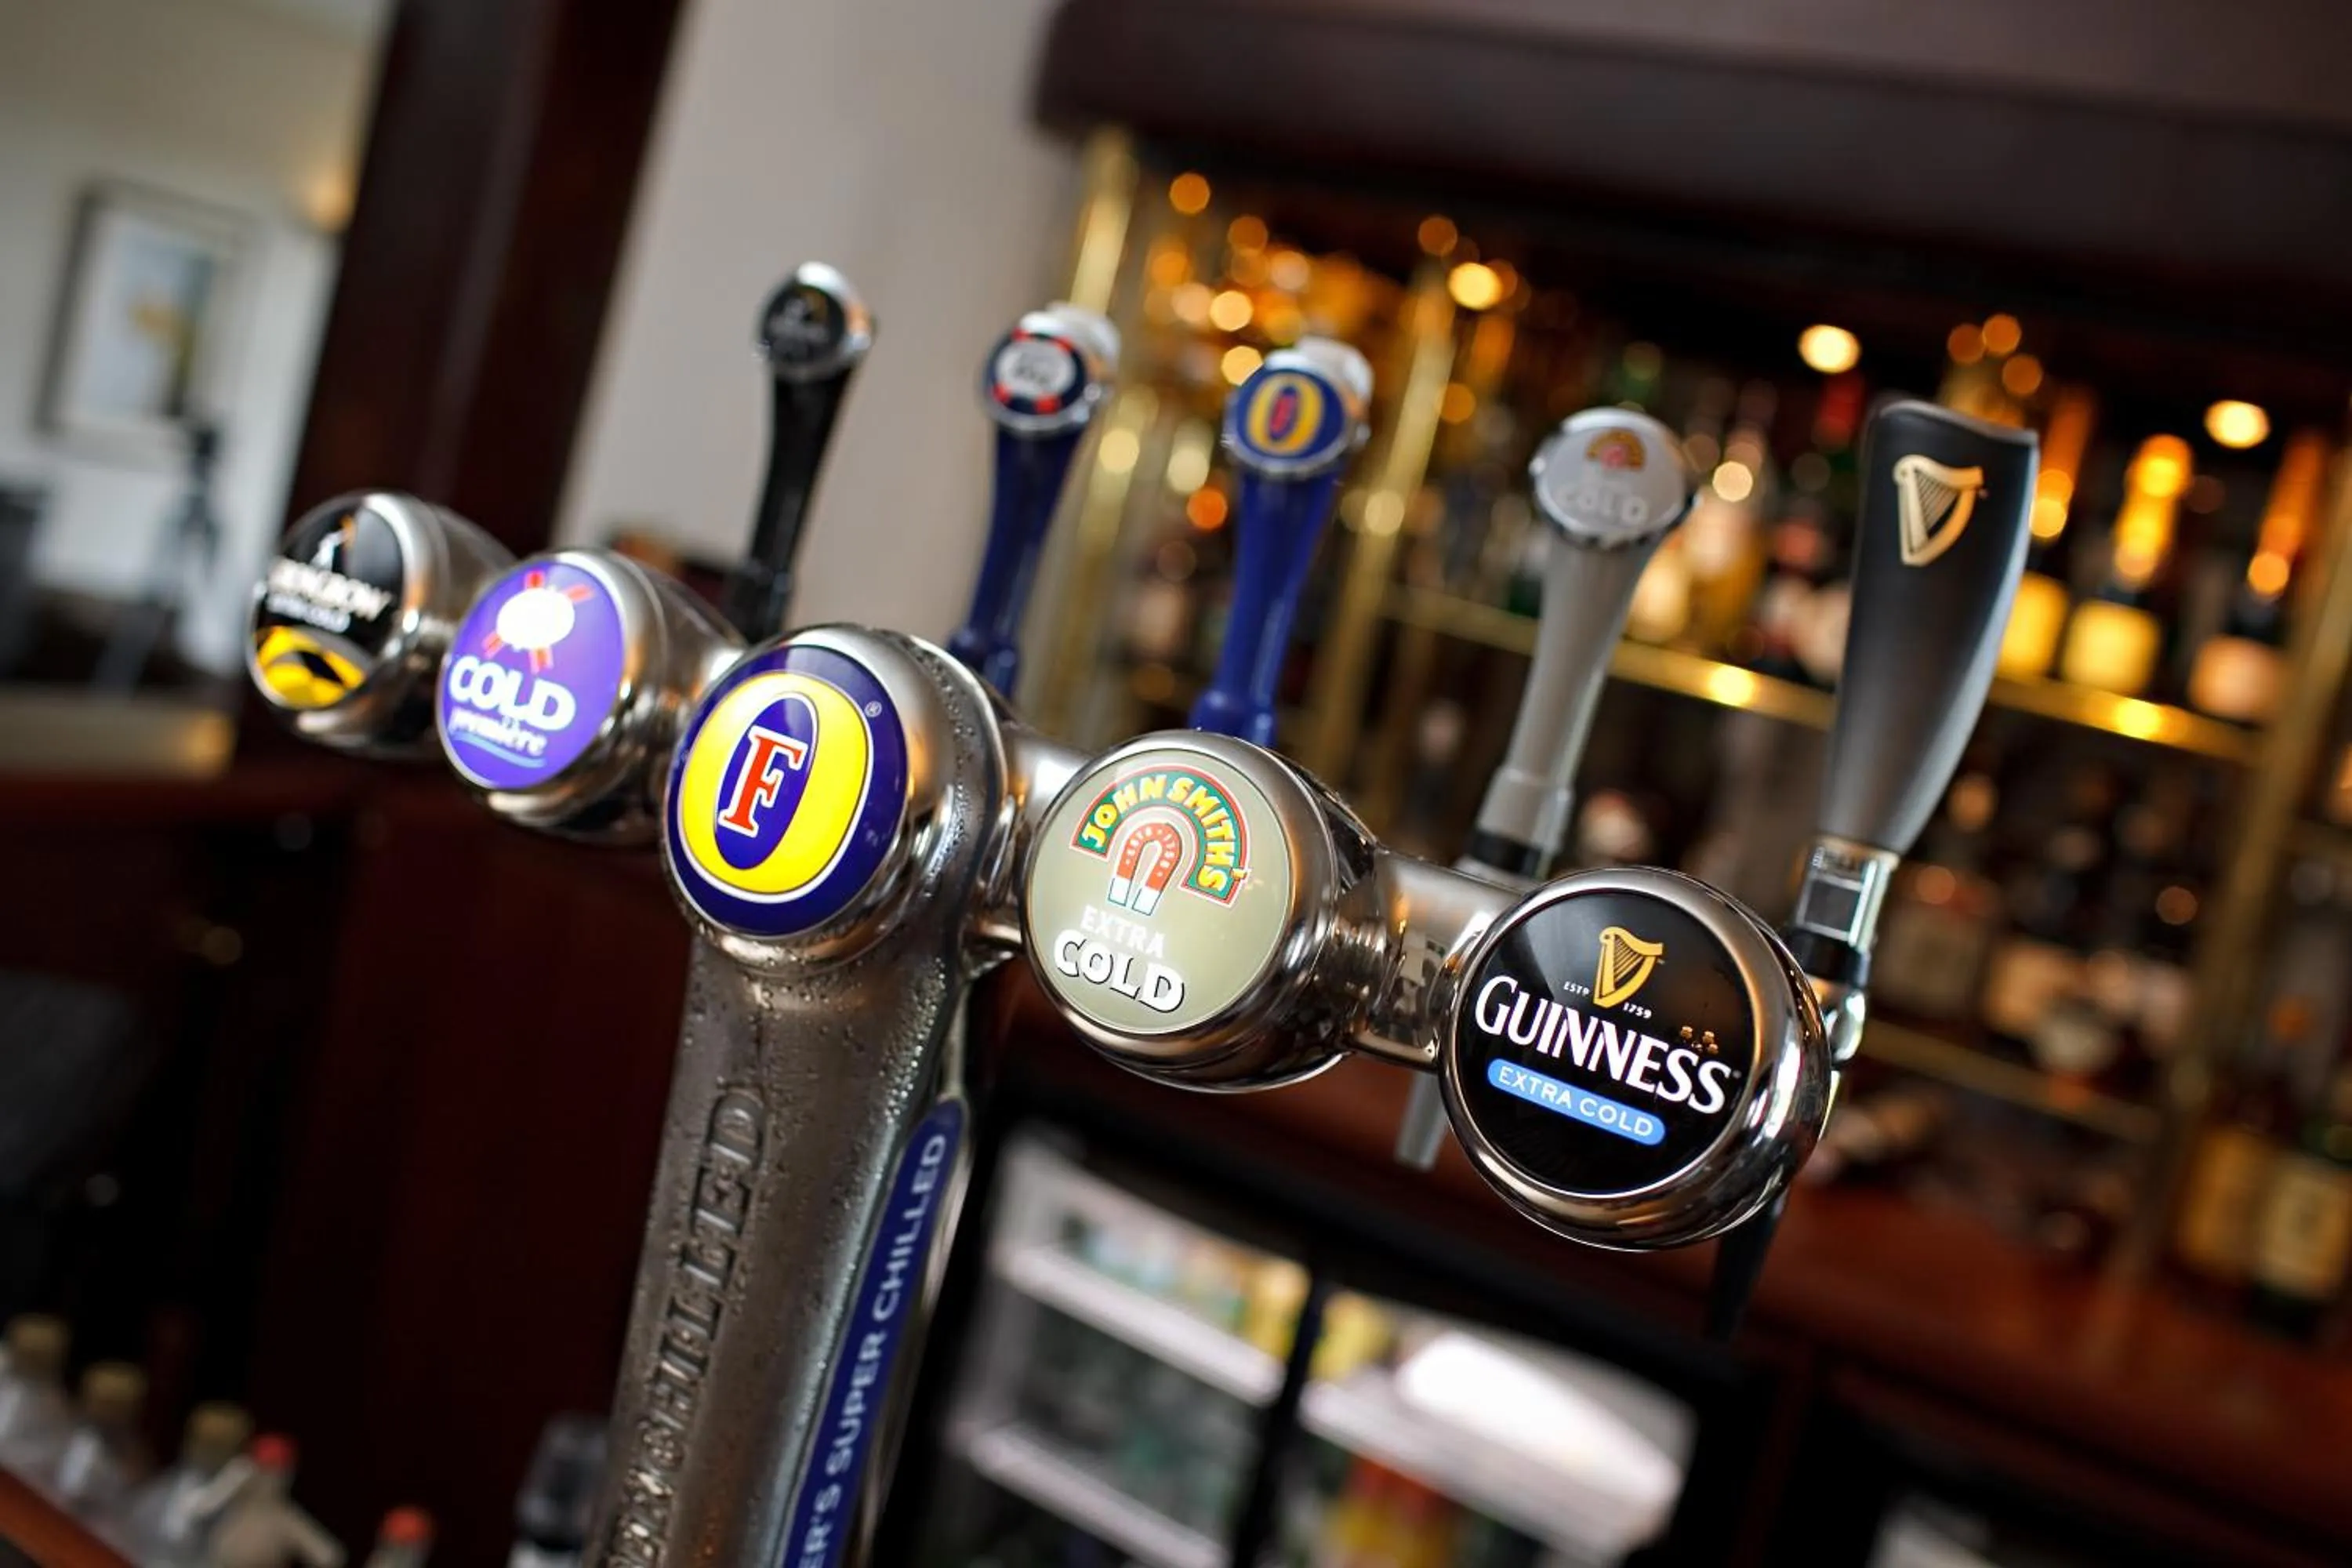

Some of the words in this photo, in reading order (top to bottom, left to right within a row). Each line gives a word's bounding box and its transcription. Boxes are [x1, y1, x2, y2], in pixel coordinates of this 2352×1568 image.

[448, 655, 576, 731] COLD
[1081, 774, 1167, 848] JOHN
[1167, 777, 1252, 891] SMITH'S
[1054, 929, 1185, 1013] COLD
[1081, 905, 1165, 958] EXTRA
[1475, 975, 1733, 1114] GUINNESS
[1623, 1002, 1652, 1018] 1759
[1498, 1065, 1573, 1108] EXTRA
[1580, 1098, 1654, 1138] COLD
[826, 1330, 887, 1475] SUPER
[873, 1134, 947, 1322] CHILLED
